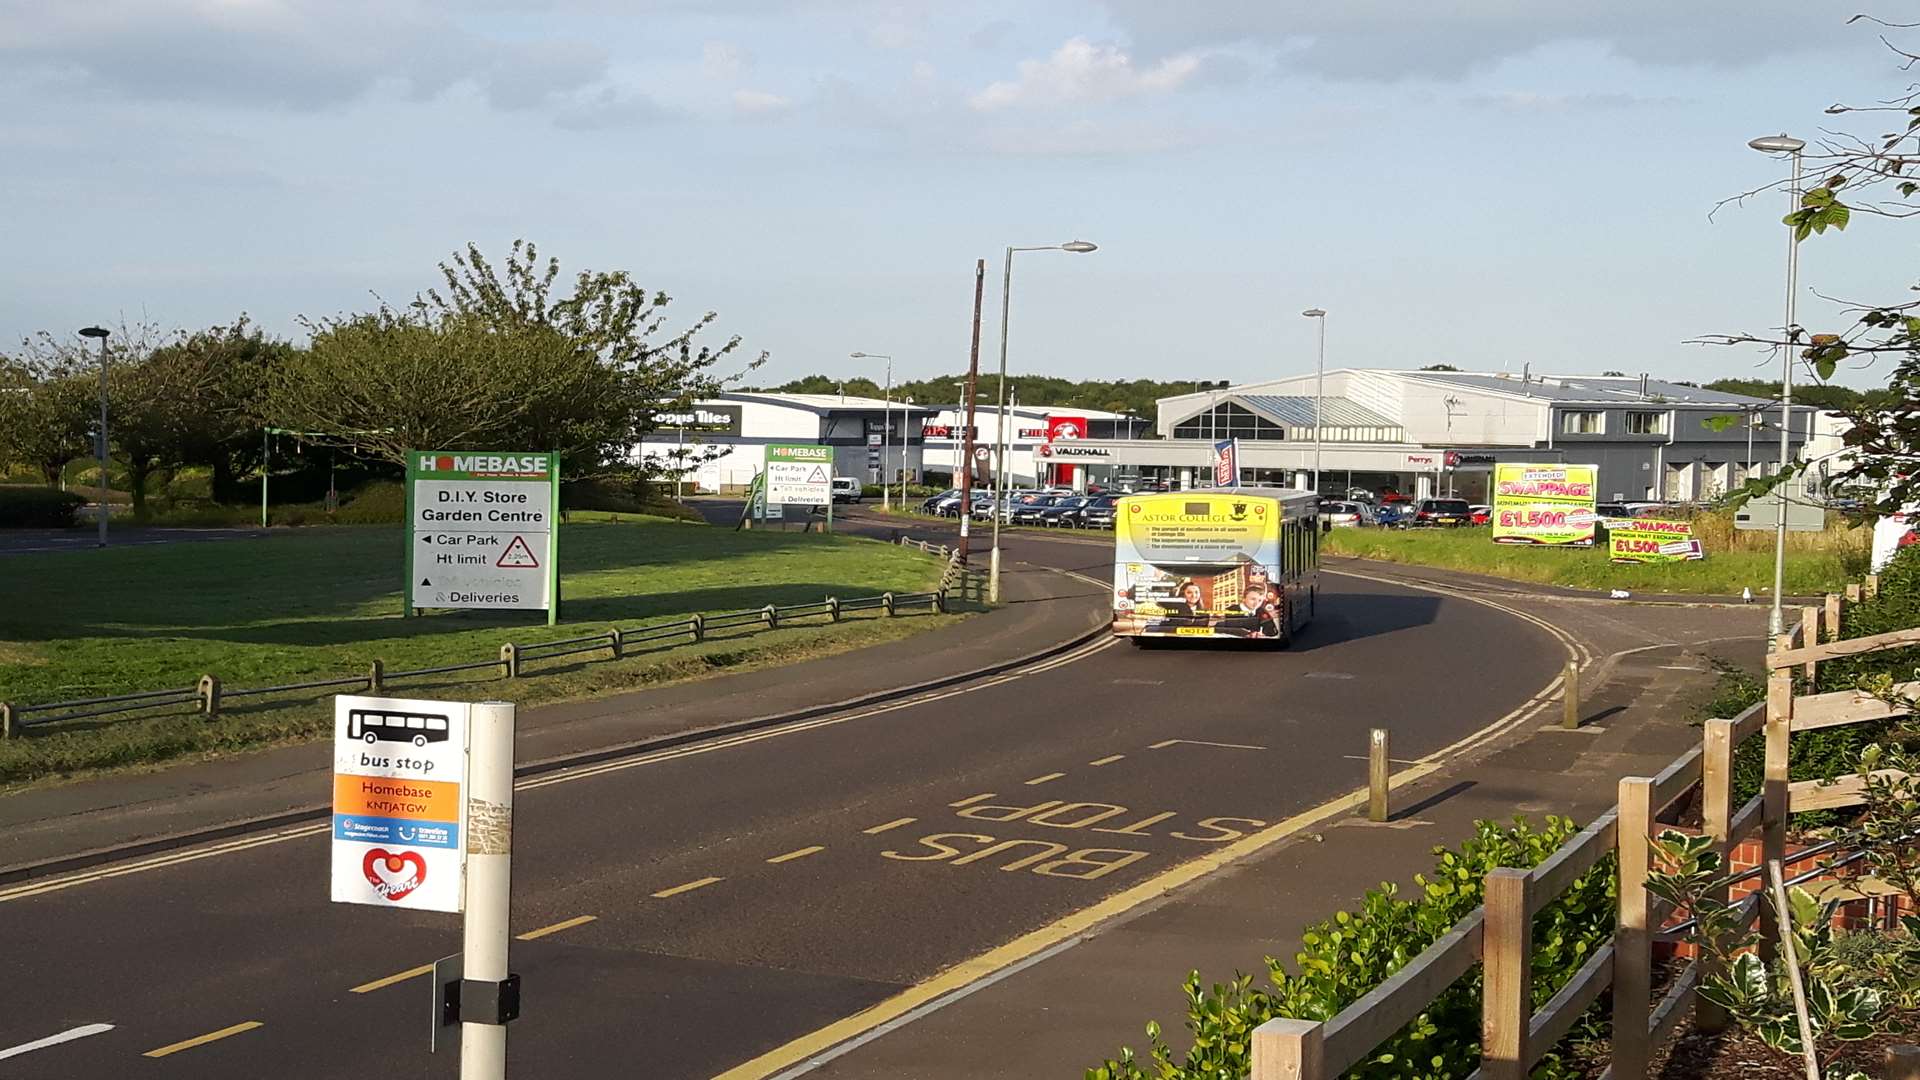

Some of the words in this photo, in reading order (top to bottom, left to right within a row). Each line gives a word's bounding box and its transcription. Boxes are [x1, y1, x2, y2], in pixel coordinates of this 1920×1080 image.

[695, 410, 731, 423] Tiles
[773, 447, 826, 457] HOMEBASE
[1055, 448, 1110, 456] VAUXHALL
[420, 456, 547, 472] HOMEBASE
[1408, 455, 1432, 464] Perrys
[1500, 480, 1590, 496] SWAPPAGE
[439, 491, 477, 503] D.I.Y.
[484, 491, 527, 503] Store
[422, 509, 482, 522] Garden
[488, 510, 542, 522] Centre
[1142, 514, 1176, 522] ASTOR
[1632, 520, 1689, 532] SWAPPAGE
[437, 534, 461, 545] Car
[467, 535, 499, 545] Park
[437, 554, 452, 564] Ht
[458, 554, 487, 565] limit
[450, 592, 519, 603] Deliveries
[361, 752, 390, 768] bus
[396, 757, 434, 774] stop
[362, 782, 433, 799] Homebase
[366, 801, 428, 813] KNTJATGW
[956, 800, 1267, 841] STOP
[881, 833, 1150, 880] BUS
[373, 876, 420, 899] Heart
